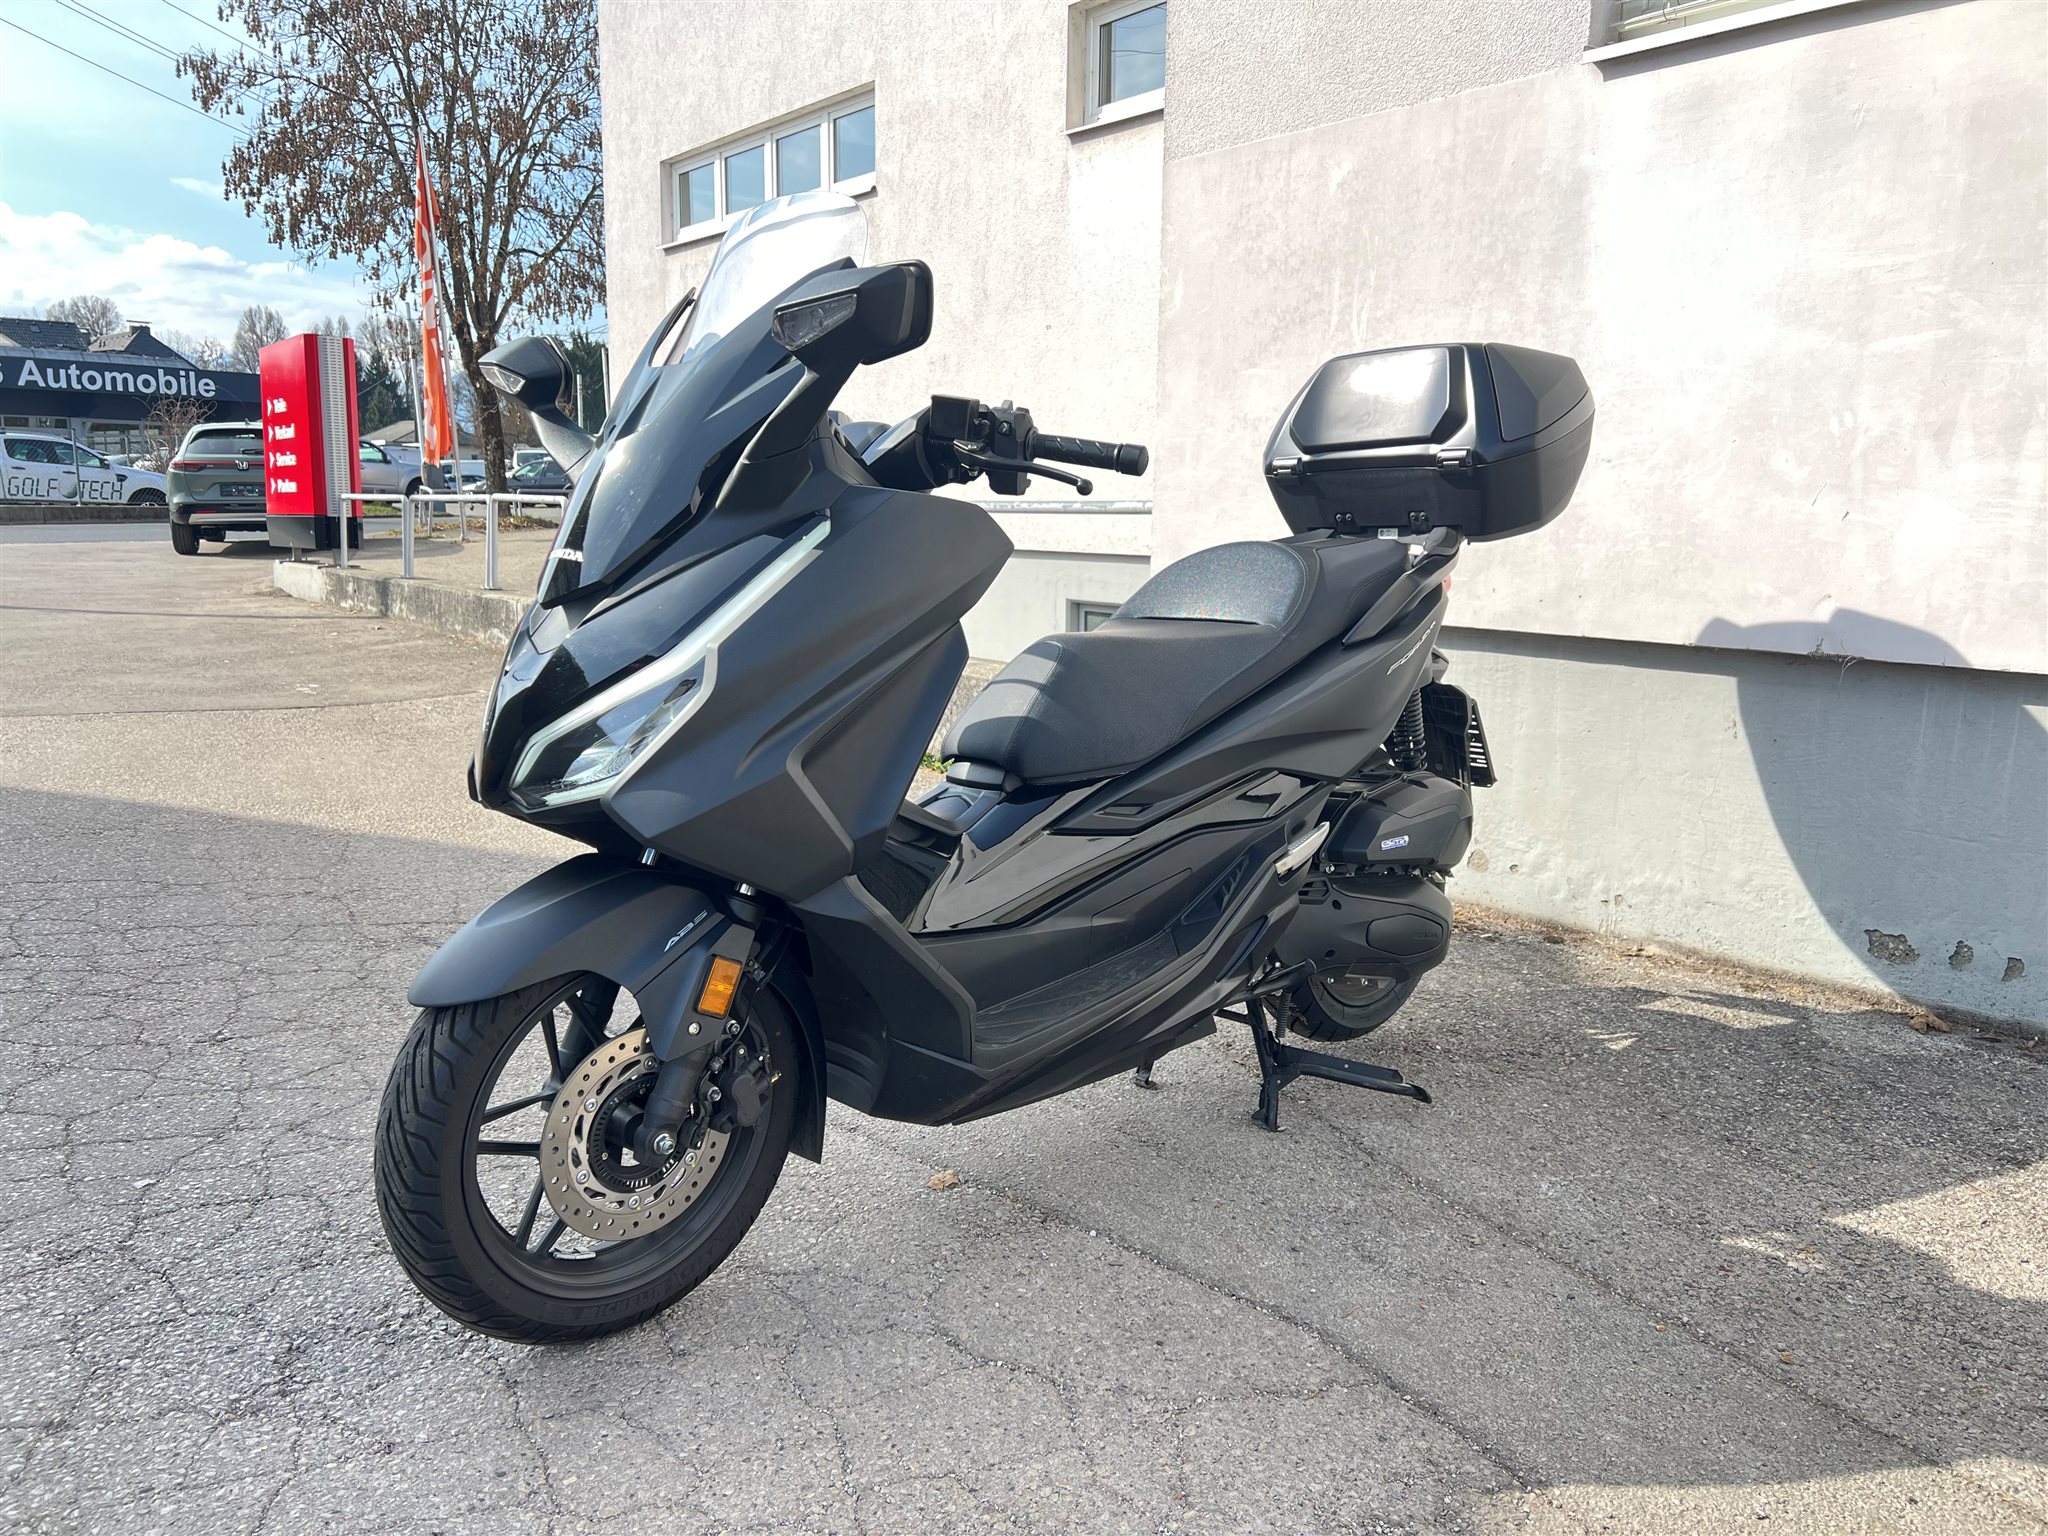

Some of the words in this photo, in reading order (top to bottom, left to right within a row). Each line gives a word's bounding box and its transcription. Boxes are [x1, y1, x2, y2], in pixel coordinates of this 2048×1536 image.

[18, 360, 216, 398] Automobile
[8, 477, 58, 497] GOLF
[80, 480, 123, 500] TECH
[548, 548, 585, 562] NDA
[664, 909, 708, 952] ABS
